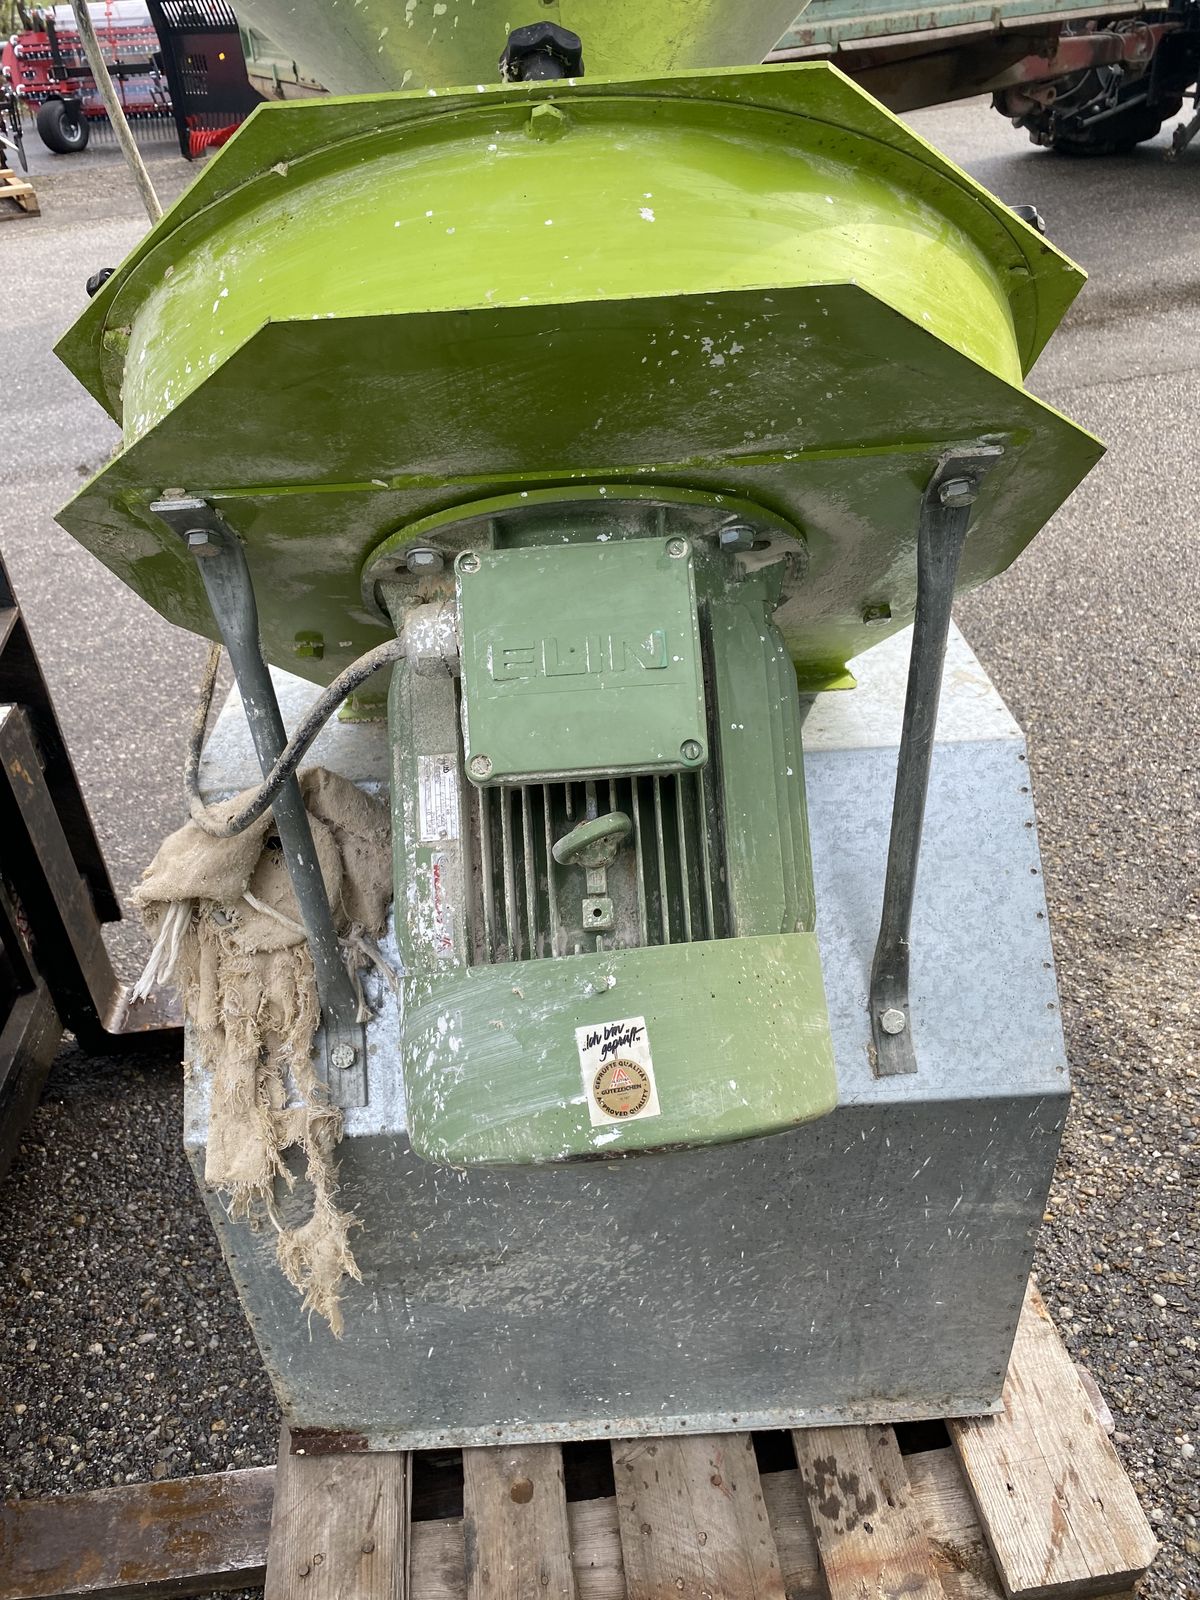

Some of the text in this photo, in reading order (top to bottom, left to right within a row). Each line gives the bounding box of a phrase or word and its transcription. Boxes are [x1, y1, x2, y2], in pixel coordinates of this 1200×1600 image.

[487, 629, 668, 681] ELIN
[604, 1023, 625, 1041] bin
[596, 1088, 649, 1117] APROVED QUALITY
